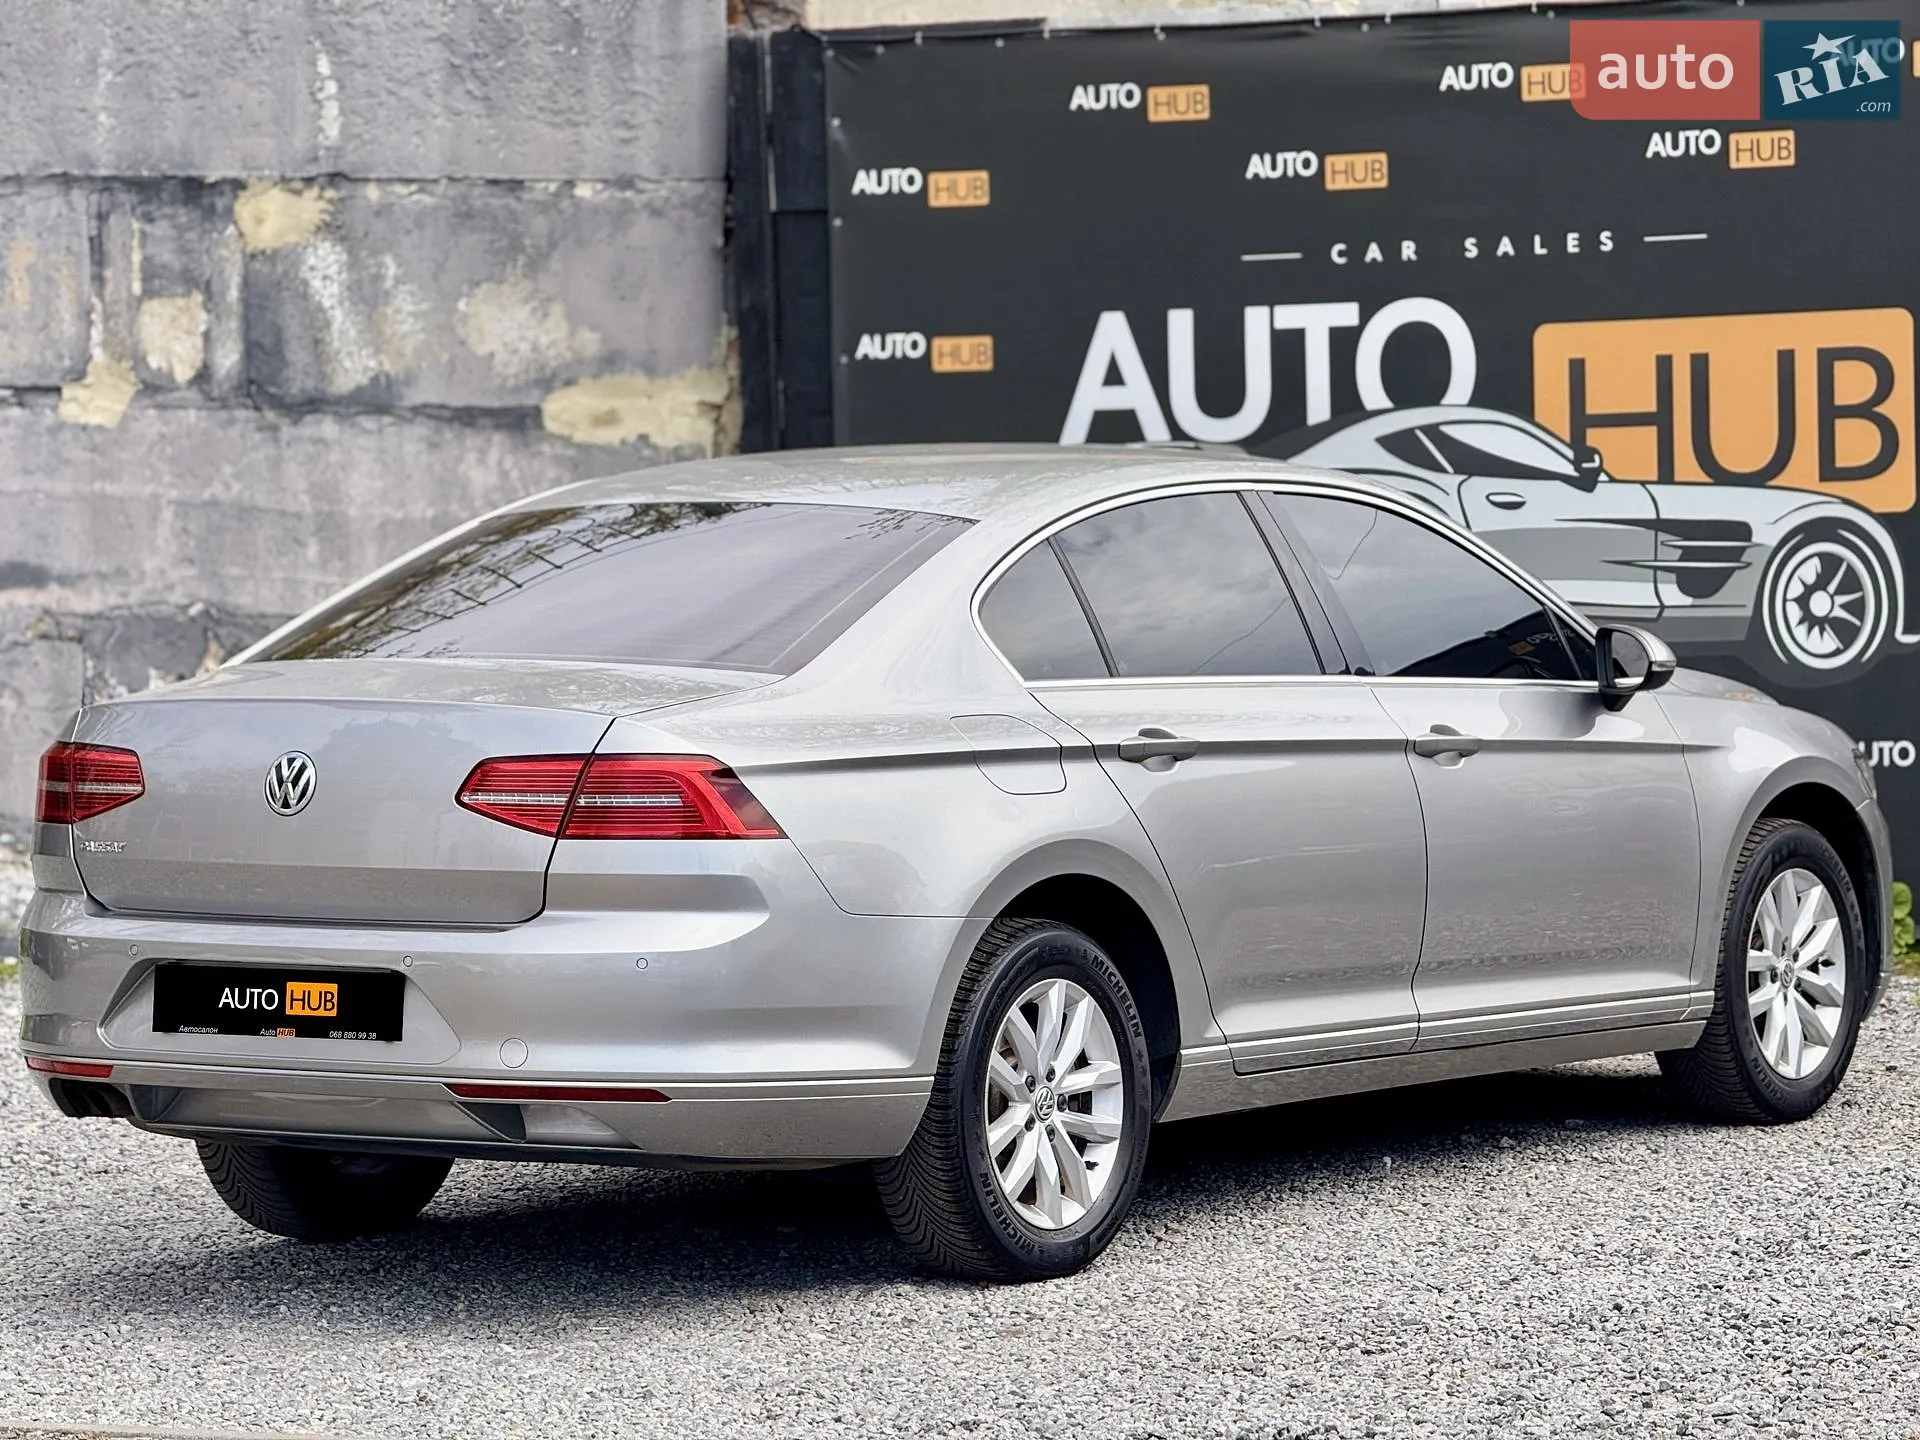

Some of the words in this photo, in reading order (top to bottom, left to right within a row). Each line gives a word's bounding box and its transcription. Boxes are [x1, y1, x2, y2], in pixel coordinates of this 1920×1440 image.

[1439, 62, 1514, 91] AUTO
[1527, 70, 1582, 96] HUB
[1070, 82, 1141, 111] AUTO
[1153, 91, 1206, 116] HUB
[1646, 129, 1721, 158] AUTO
[1735, 137, 1792, 162] HUB
[851, 167, 923, 196] AUTO
[934, 176, 986, 202] HUB
[1245, 151, 1318, 180] AUTO
[1331, 159, 1384, 185] HUB
[1331, 240, 1418, 264] CAR
[1464, 231, 1614, 258] SALES
[855, 332, 927, 361] AUTO
[938, 342, 989, 367] HUB
[1059, 297, 1476, 443] AUTO
[1569, 346, 1900, 484] HUB
[1858, 740, 1916, 767] UTO
[218, 987, 279, 1011] AUTO
[289, 989, 336, 1012] HUB
[1091, 954, 1143, 1038] MICHELIN
[260, 1028, 276, 1036] Auto
[277, 1028, 295, 1037] HUB
[980, 1172, 1036, 1256] MICHELIN
